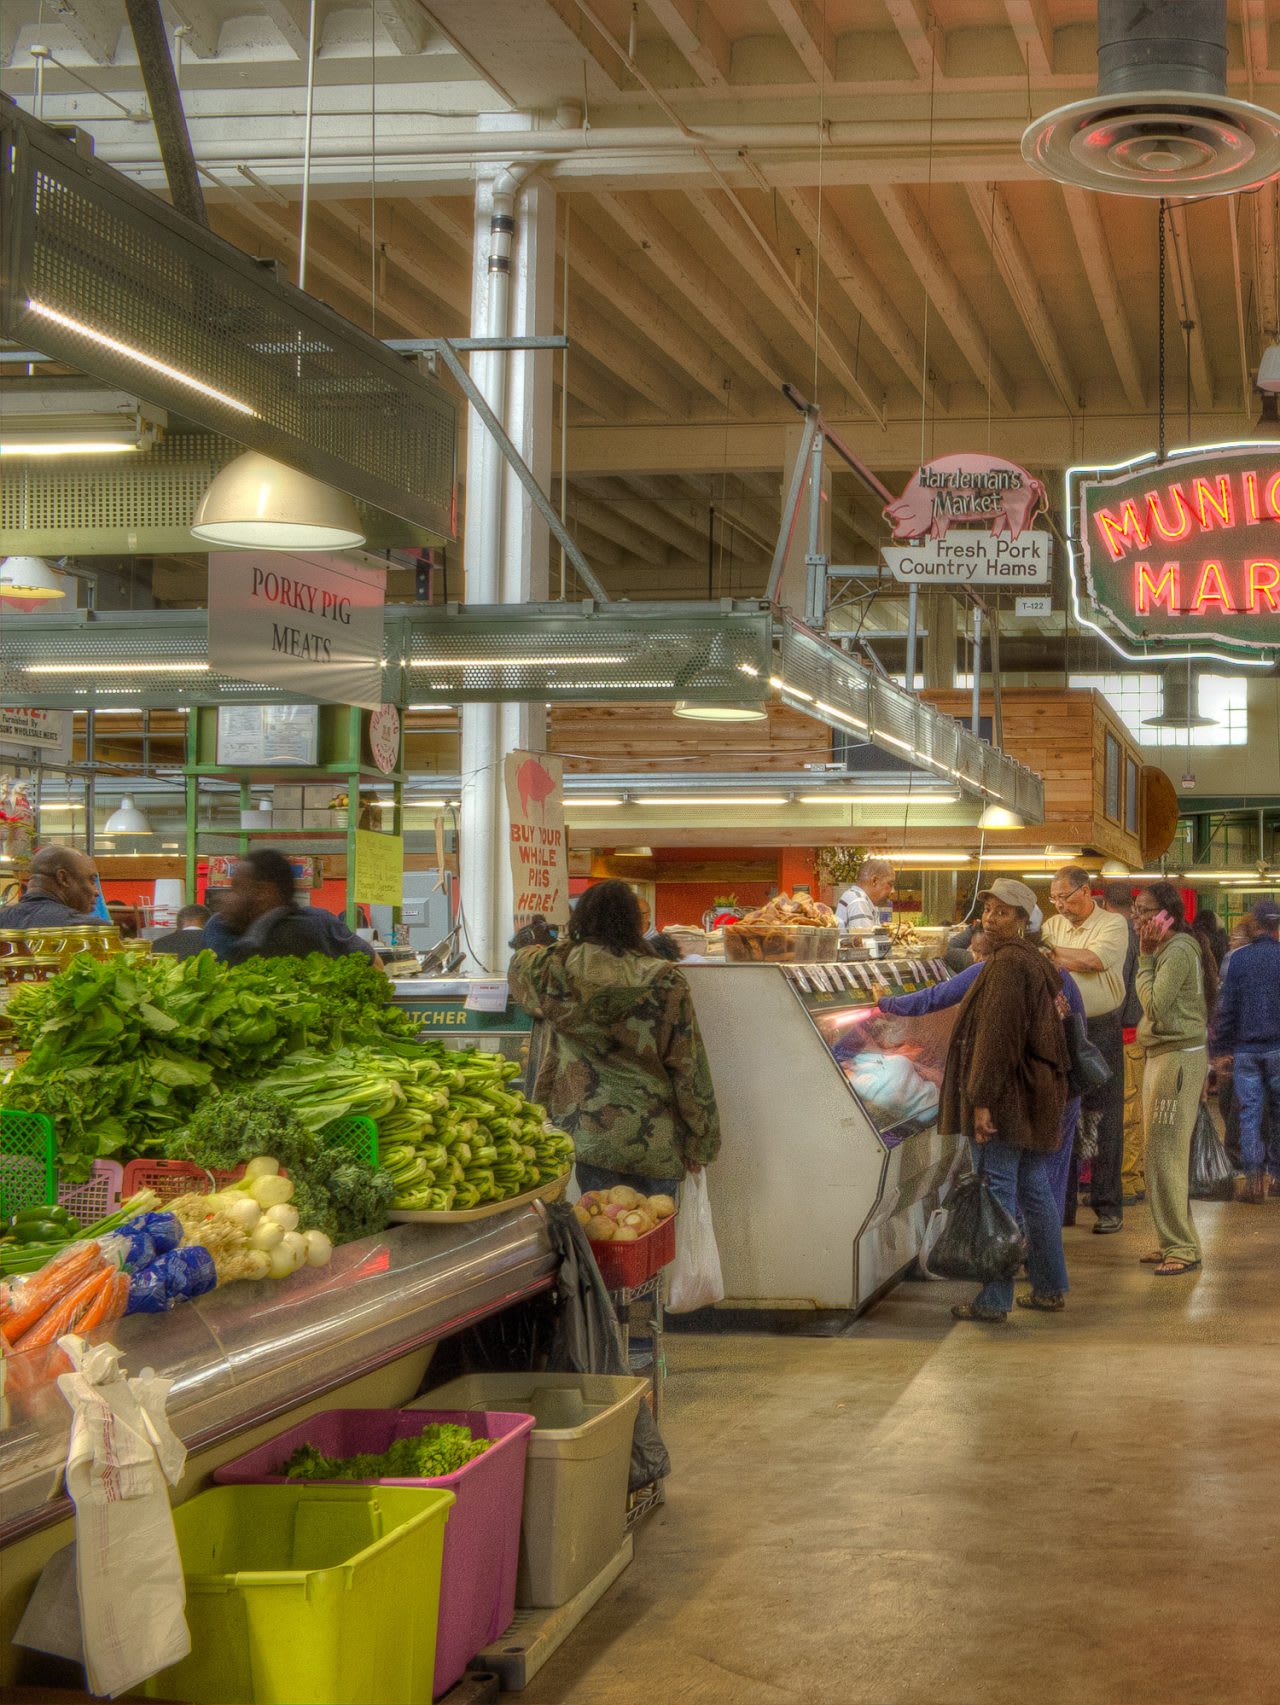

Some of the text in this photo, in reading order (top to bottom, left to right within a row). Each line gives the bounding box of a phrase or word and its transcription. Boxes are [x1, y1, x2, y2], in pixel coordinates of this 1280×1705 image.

[919, 466, 1022, 490] Hardeman's
[932, 491, 1003, 517] Market
[937, 539, 1041, 559] Fresh Pork
[899, 557, 1037, 580] Country Hams
[251, 566, 351, 625] PORKY PIG
[1022, 602, 1045, 611] T-122
[271, 622, 332, 664] MEATS
[510, 824, 535, 843] BUY
[517, 888, 559, 913] HERE!
